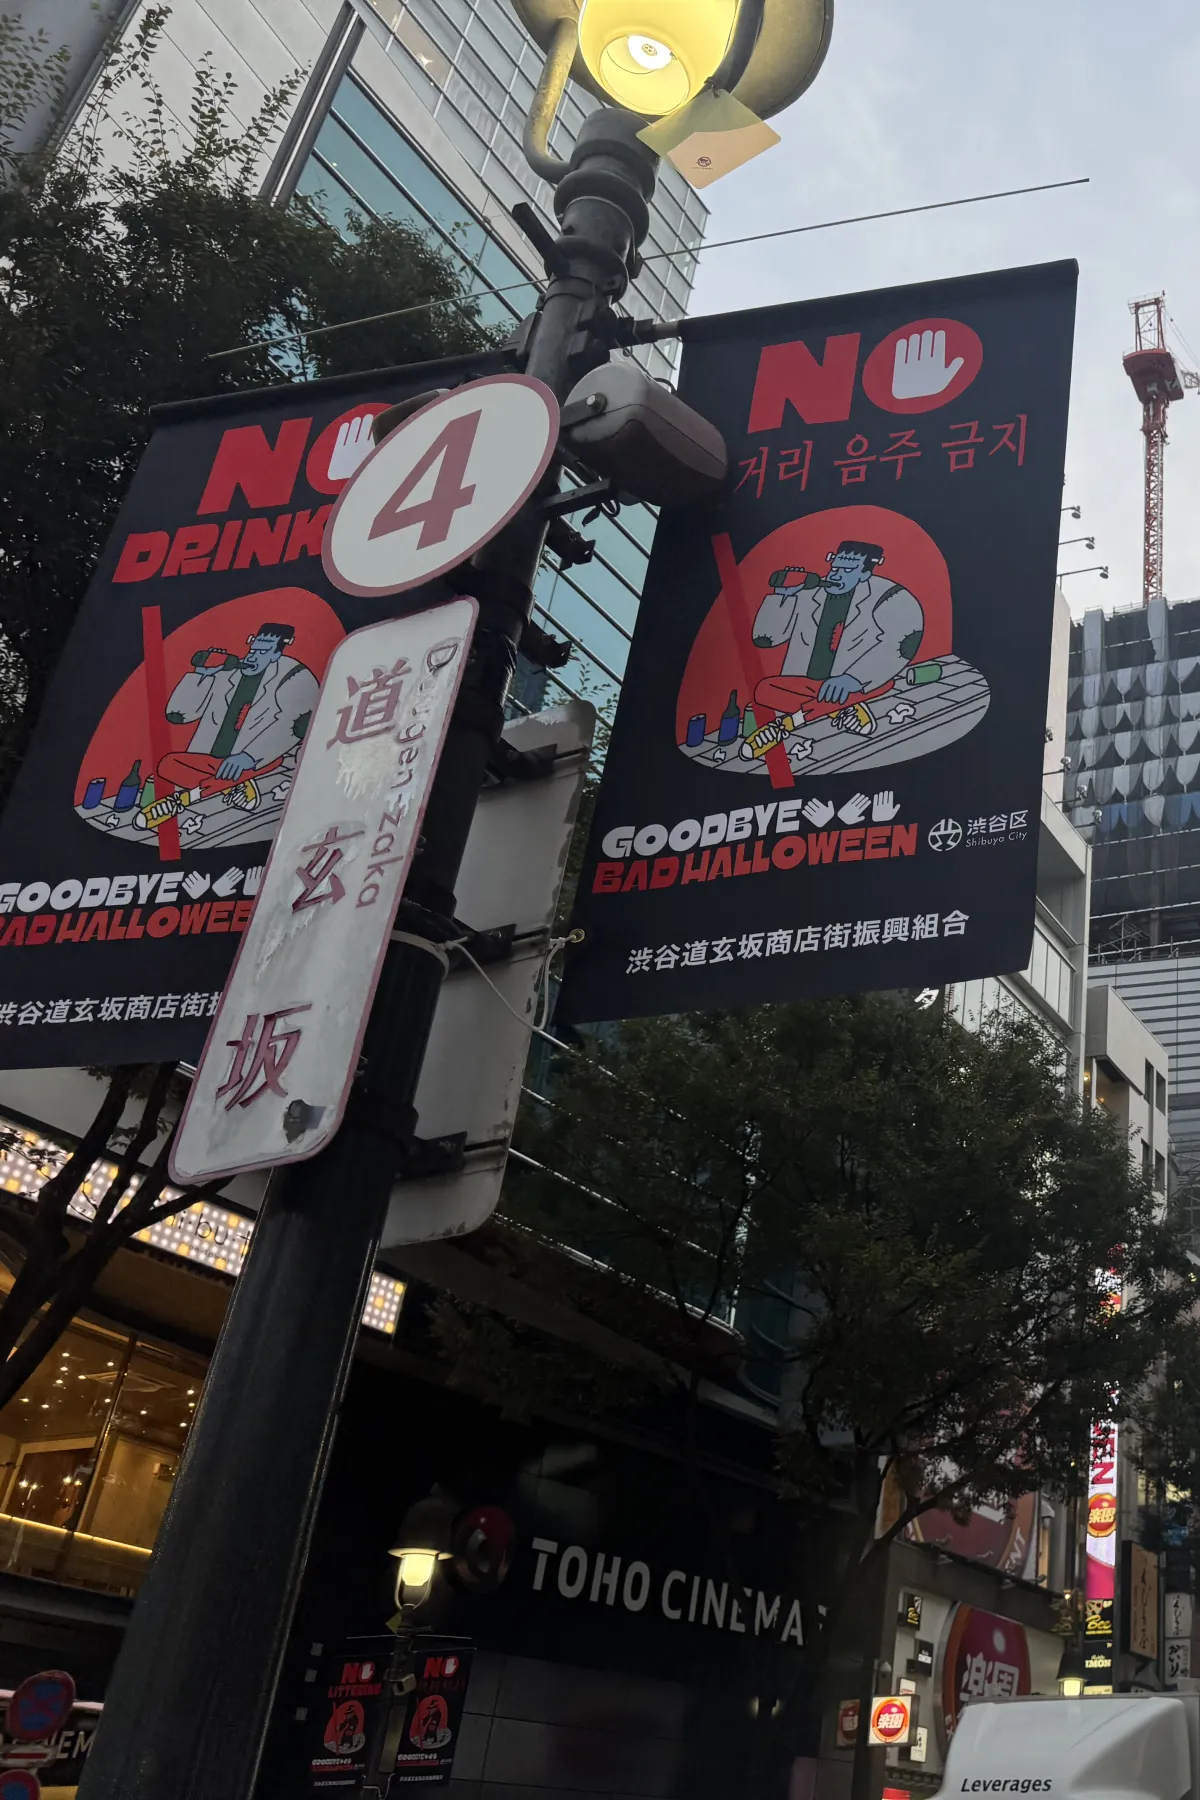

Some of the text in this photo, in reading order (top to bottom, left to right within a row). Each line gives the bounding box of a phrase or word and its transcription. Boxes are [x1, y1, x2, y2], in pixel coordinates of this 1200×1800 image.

[367, 409, 482, 551] 4
[733, 414, 1028, 499] 거리 음주 금지
[112, 511, 326, 584] DRINK
[601, 799, 803, 859] GOODBYE
[966, 830, 1028, 848] Shibuya City
[967, 809, 1029, 836] 渋谷区
[215, 657, 411, 1111] 道玄坂
[55, 901, 254, 943] HALLOWEE
[625, 910, 969, 975] 渋谷道玄坂商店街振興組合
[532, 1537, 828, 1646] TOHO CINEMA
[877, 1713, 904, 1729] 楽園
[961, 1778, 1053, 1793] Leverages
